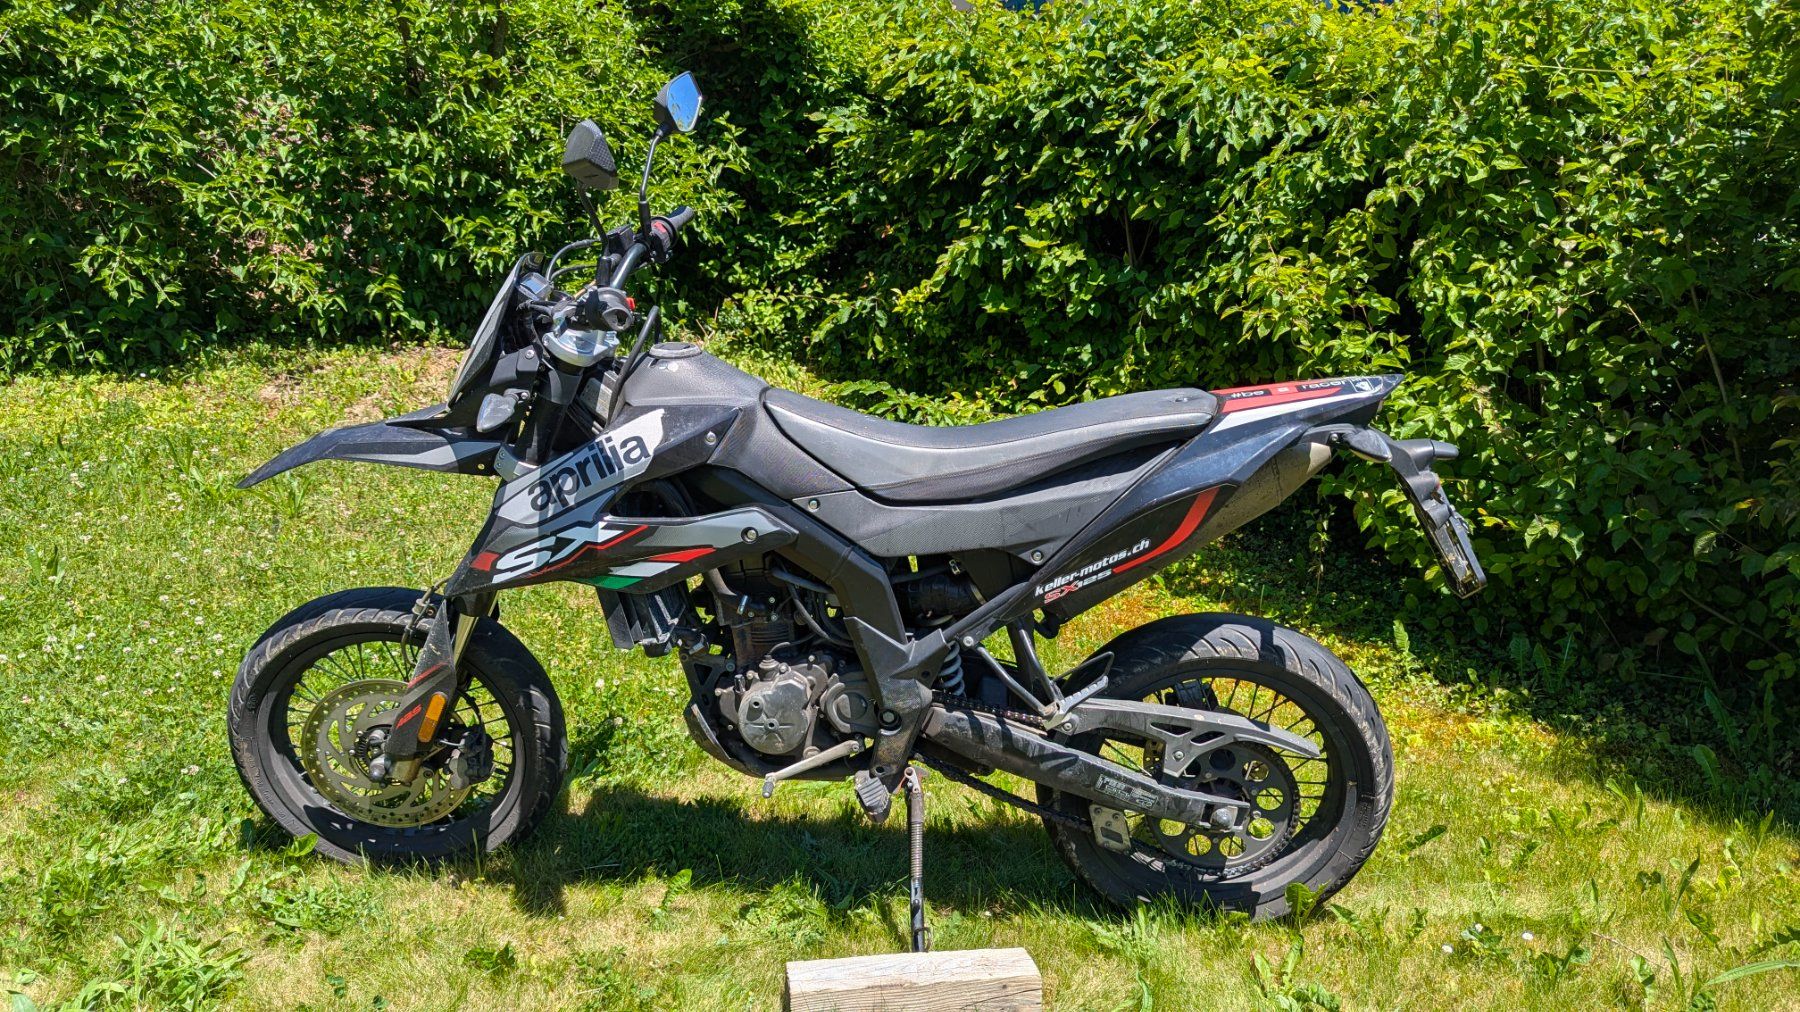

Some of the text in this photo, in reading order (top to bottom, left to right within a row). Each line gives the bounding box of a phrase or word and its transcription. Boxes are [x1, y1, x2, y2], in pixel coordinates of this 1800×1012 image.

[1231, 389, 1264, 398] #be
[527, 432, 651, 512] aprilia
[491, 521, 624, 584] SX
[1035, 539, 1150, 597] keller-motos.ch
